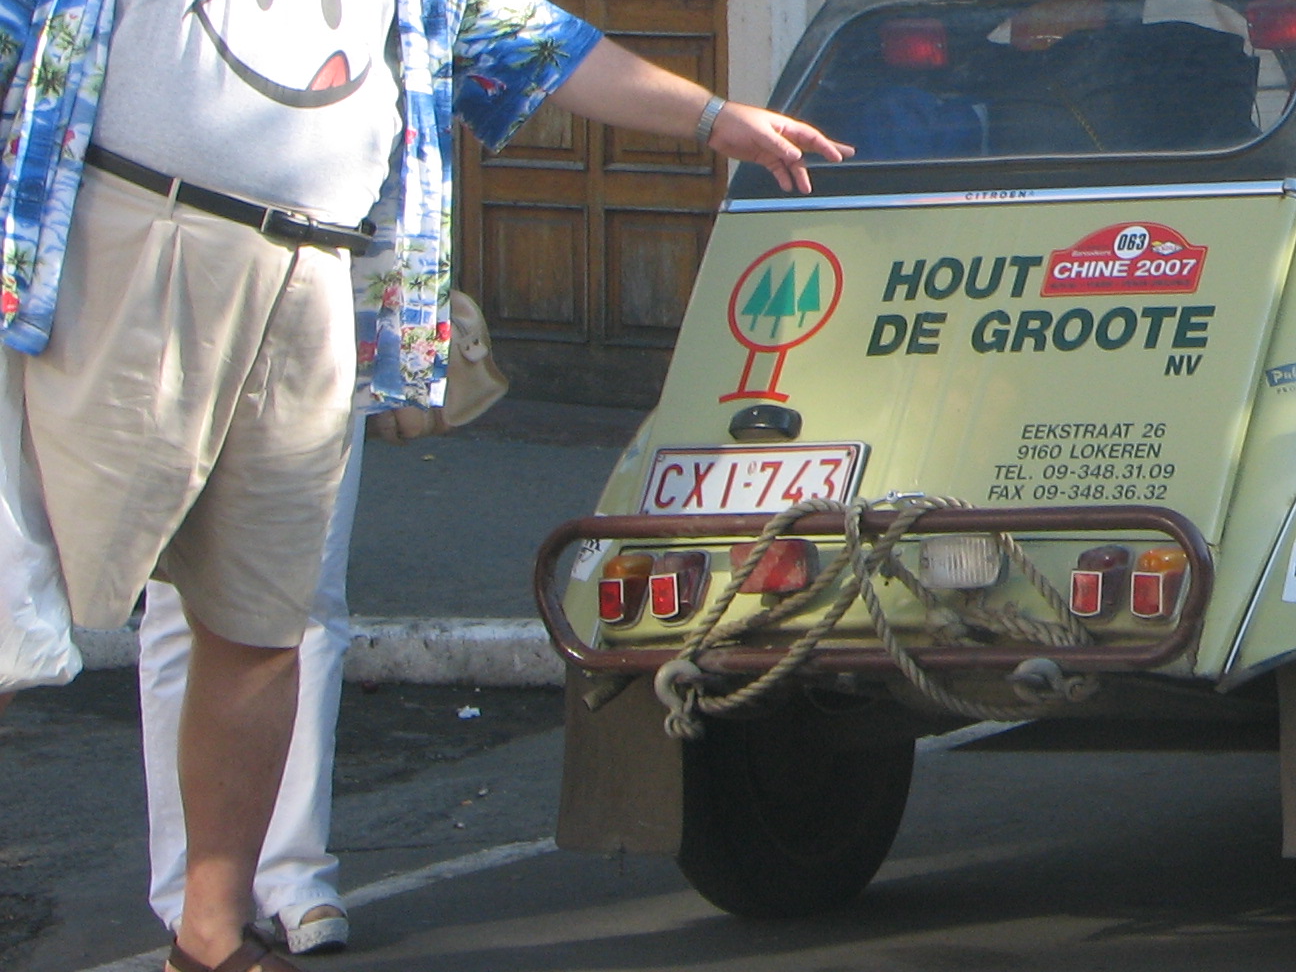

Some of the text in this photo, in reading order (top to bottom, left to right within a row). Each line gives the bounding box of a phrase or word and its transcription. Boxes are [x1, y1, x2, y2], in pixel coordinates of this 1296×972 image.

[1116, 233, 1147, 251] 063
[1053, 259, 1197, 279] CHINE 2007
[882, 256, 1044, 302] HOUT
[866, 305, 1216, 356] DE GROOTE
[1163, 354, 1204, 377] NV
[1021, 423, 1166, 440] EEKSTRAAT 26
[1017, 443, 1162, 459] 9160 LOKEREN
[994, 464, 1176, 480] TEL. 09-348.31.09
[988, 485, 1168, 500] FAX 09-348.36.32
